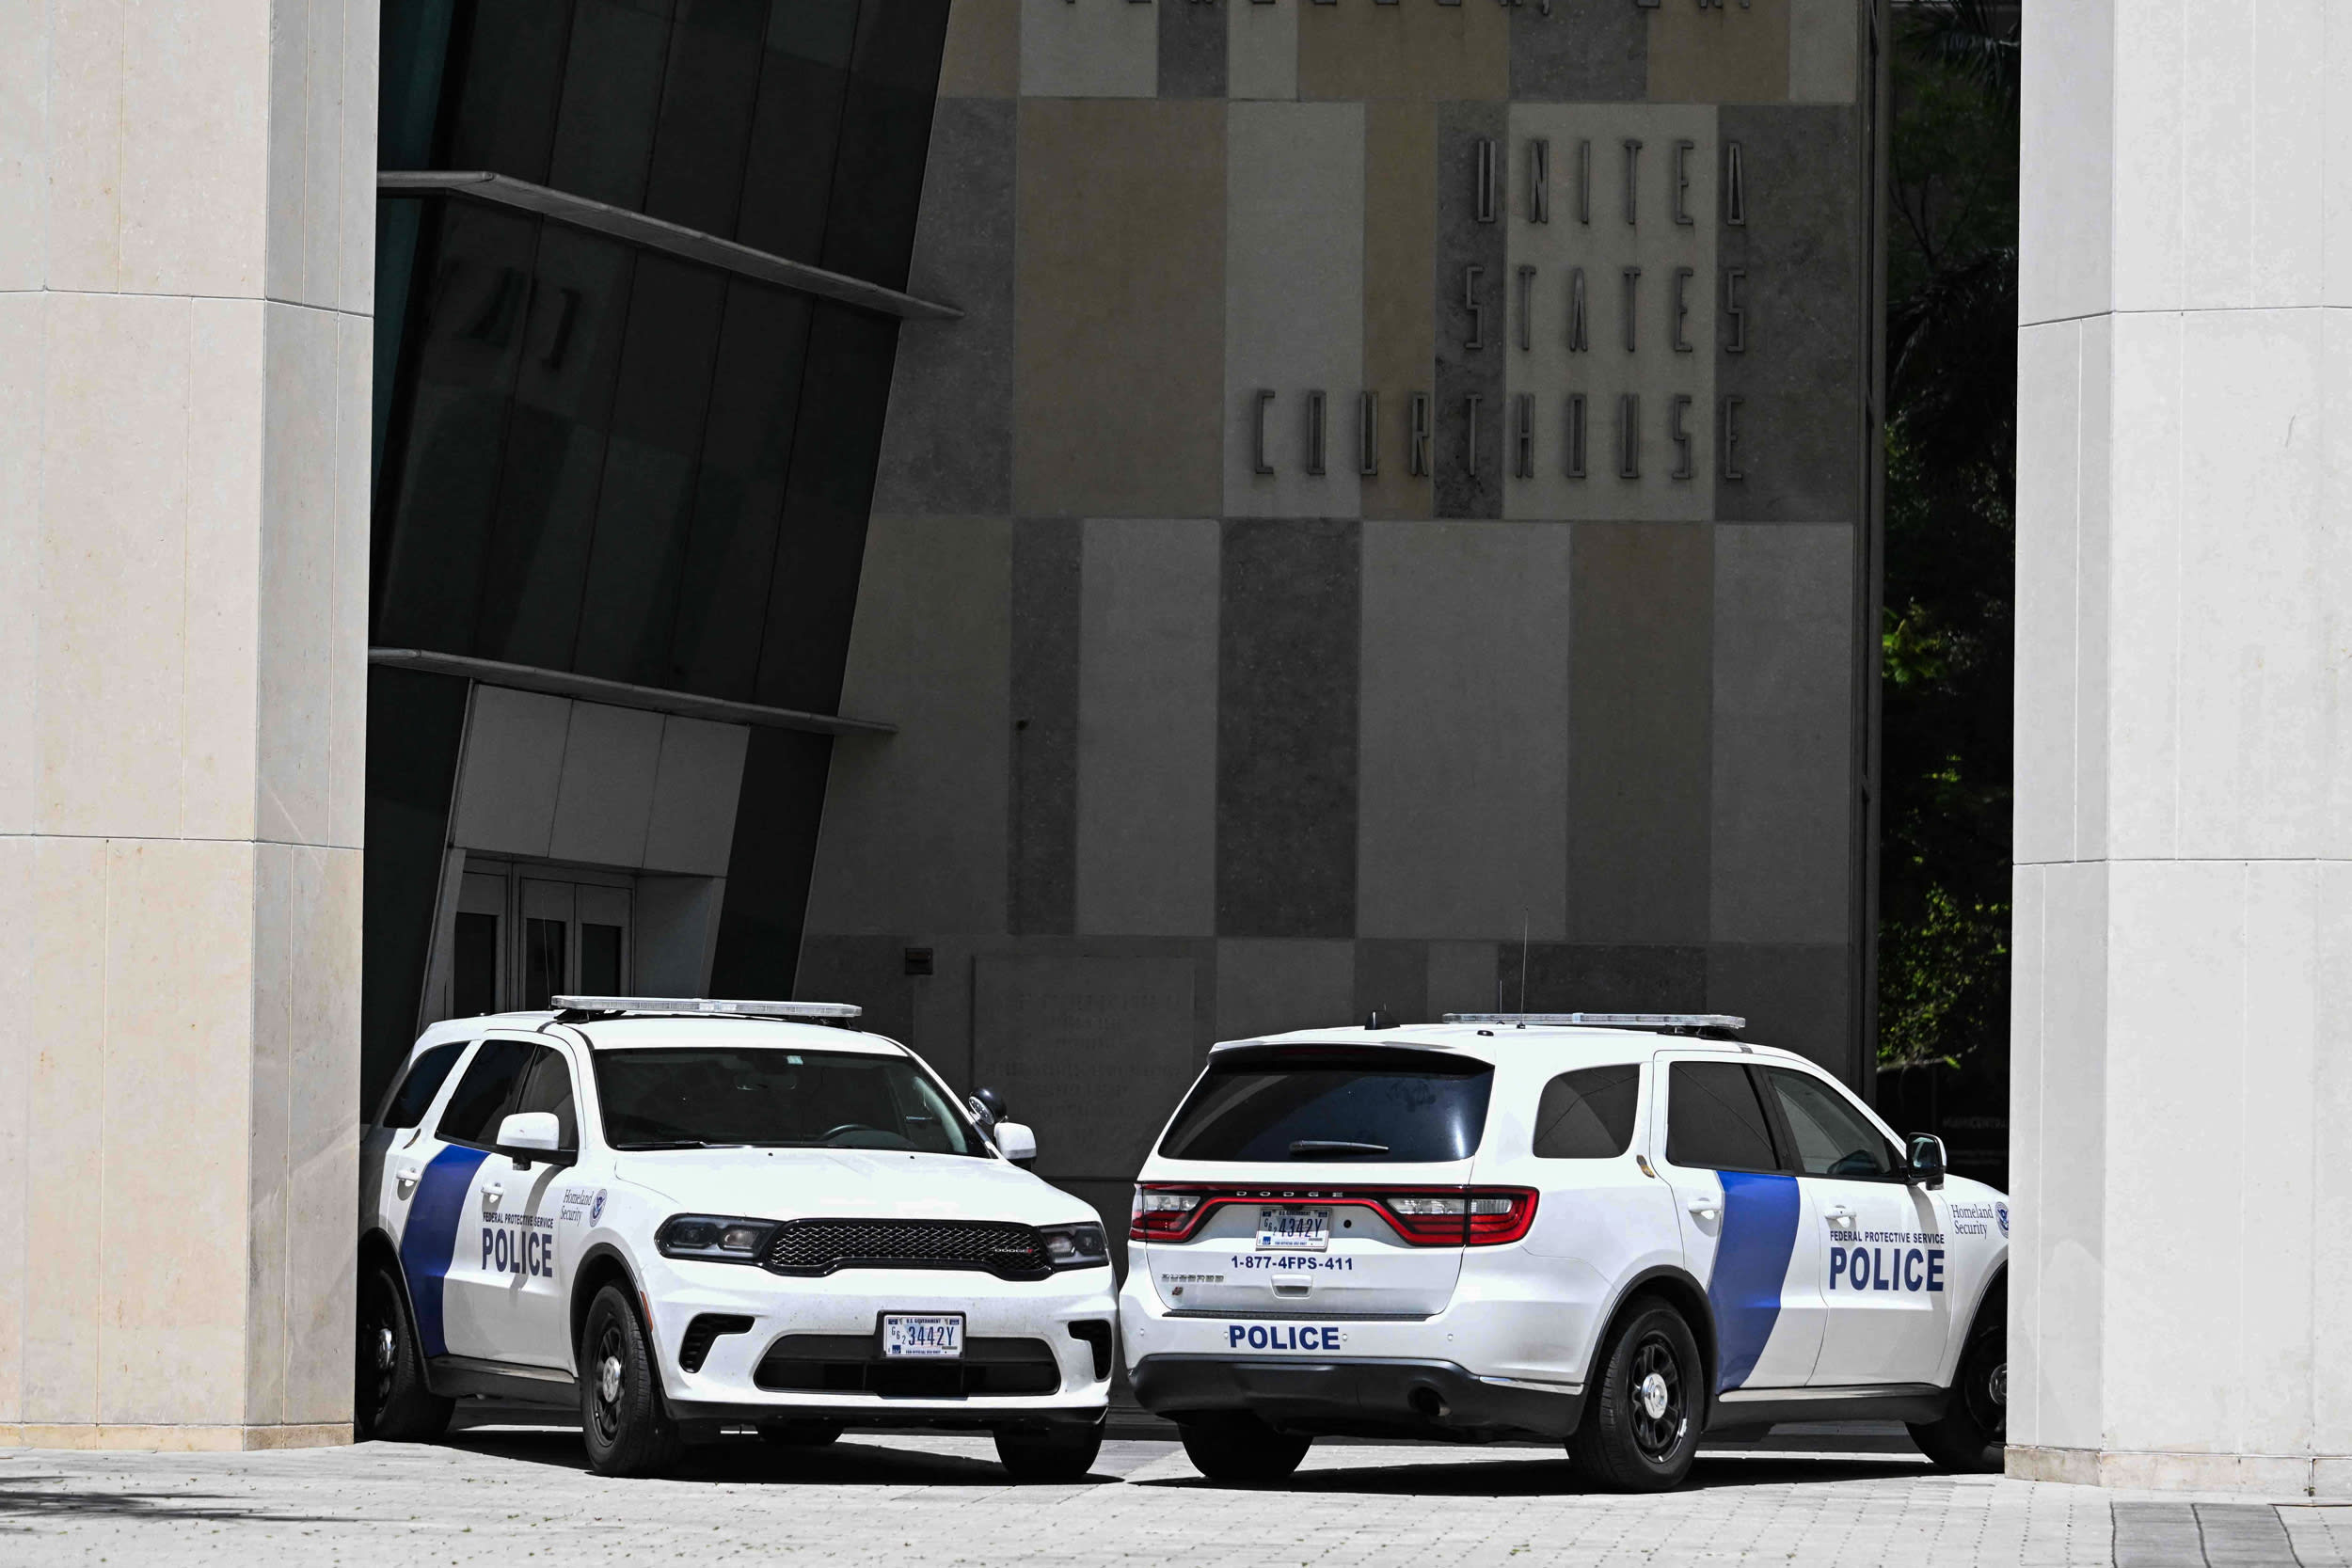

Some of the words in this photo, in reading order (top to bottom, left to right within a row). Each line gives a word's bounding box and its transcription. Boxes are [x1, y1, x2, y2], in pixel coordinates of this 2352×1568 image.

[1476, 138, 1746, 226] UNITED
[1464, 264, 1746, 353] STATES
[1254, 388, 1745, 480] COURTHOUSE
[564, 1189, 594, 1206] Homeland
[483, 1212, 503, 1223] FEDERAL
[504, 1213, 533, 1226] PROTECTIVE
[534, 1217, 554, 1228] SERVICE
[561, 1205, 582, 1227] Security
[1950, 1203, 1994, 1219] Homeland
[1279, 1218, 1323, 1238] 4342Y
[1830, 1230, 1863, 1242] FEDERAL
[1865, 1231, 1911, 1243] PROTECTIVE
[1913, 1233, 1945, 1244] SERVICE
[1954, 1220, 1987, 1240] Security
[482, 1227, 553, 1278] POLICE
[1231, 1255, 1353, 1271] 1-877-4FPS-411
[1829, 1246, 1945, 1291] POLICE
[908, 1326, 954, 1346] 3442Y
[1228, 1324, 1341, 1352] POLICE
